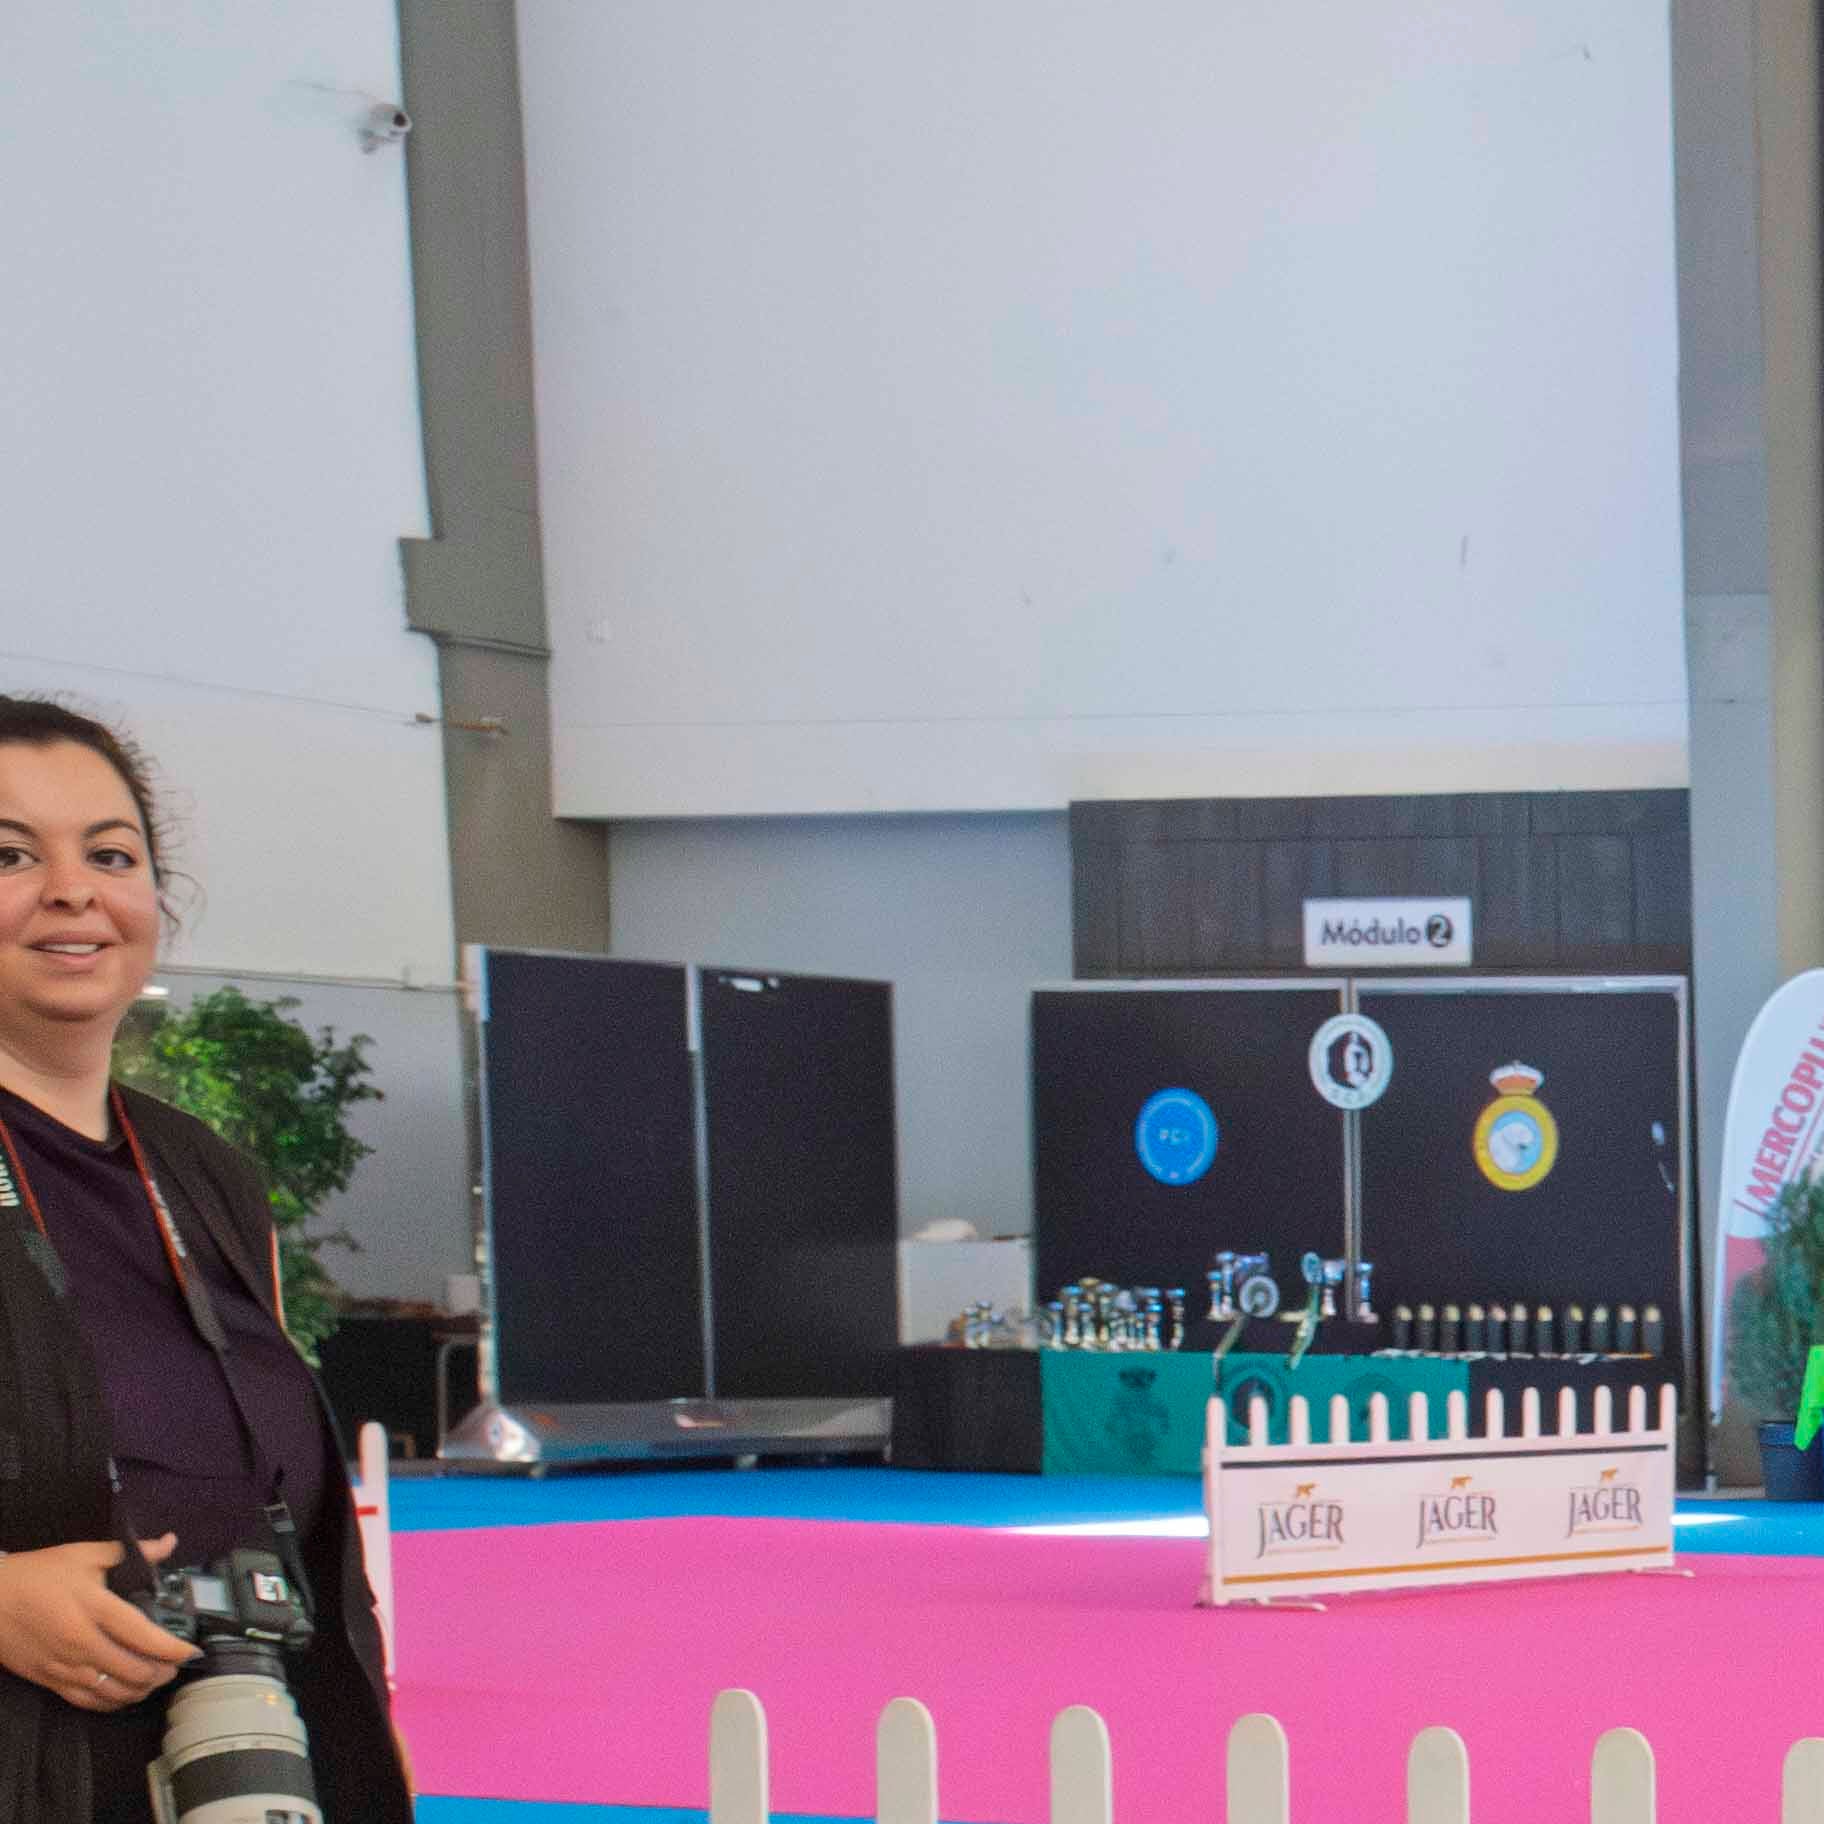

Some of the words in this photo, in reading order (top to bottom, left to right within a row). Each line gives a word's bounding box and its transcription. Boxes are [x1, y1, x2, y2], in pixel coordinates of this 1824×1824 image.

[1320, 916, 1421, 946] Módulo
[1256, 1502, 1345, 1560] JAGER
[1415, 1493, 1499, 1549] JAGER
[1567, 1486, 1644, 1539] JAGER
